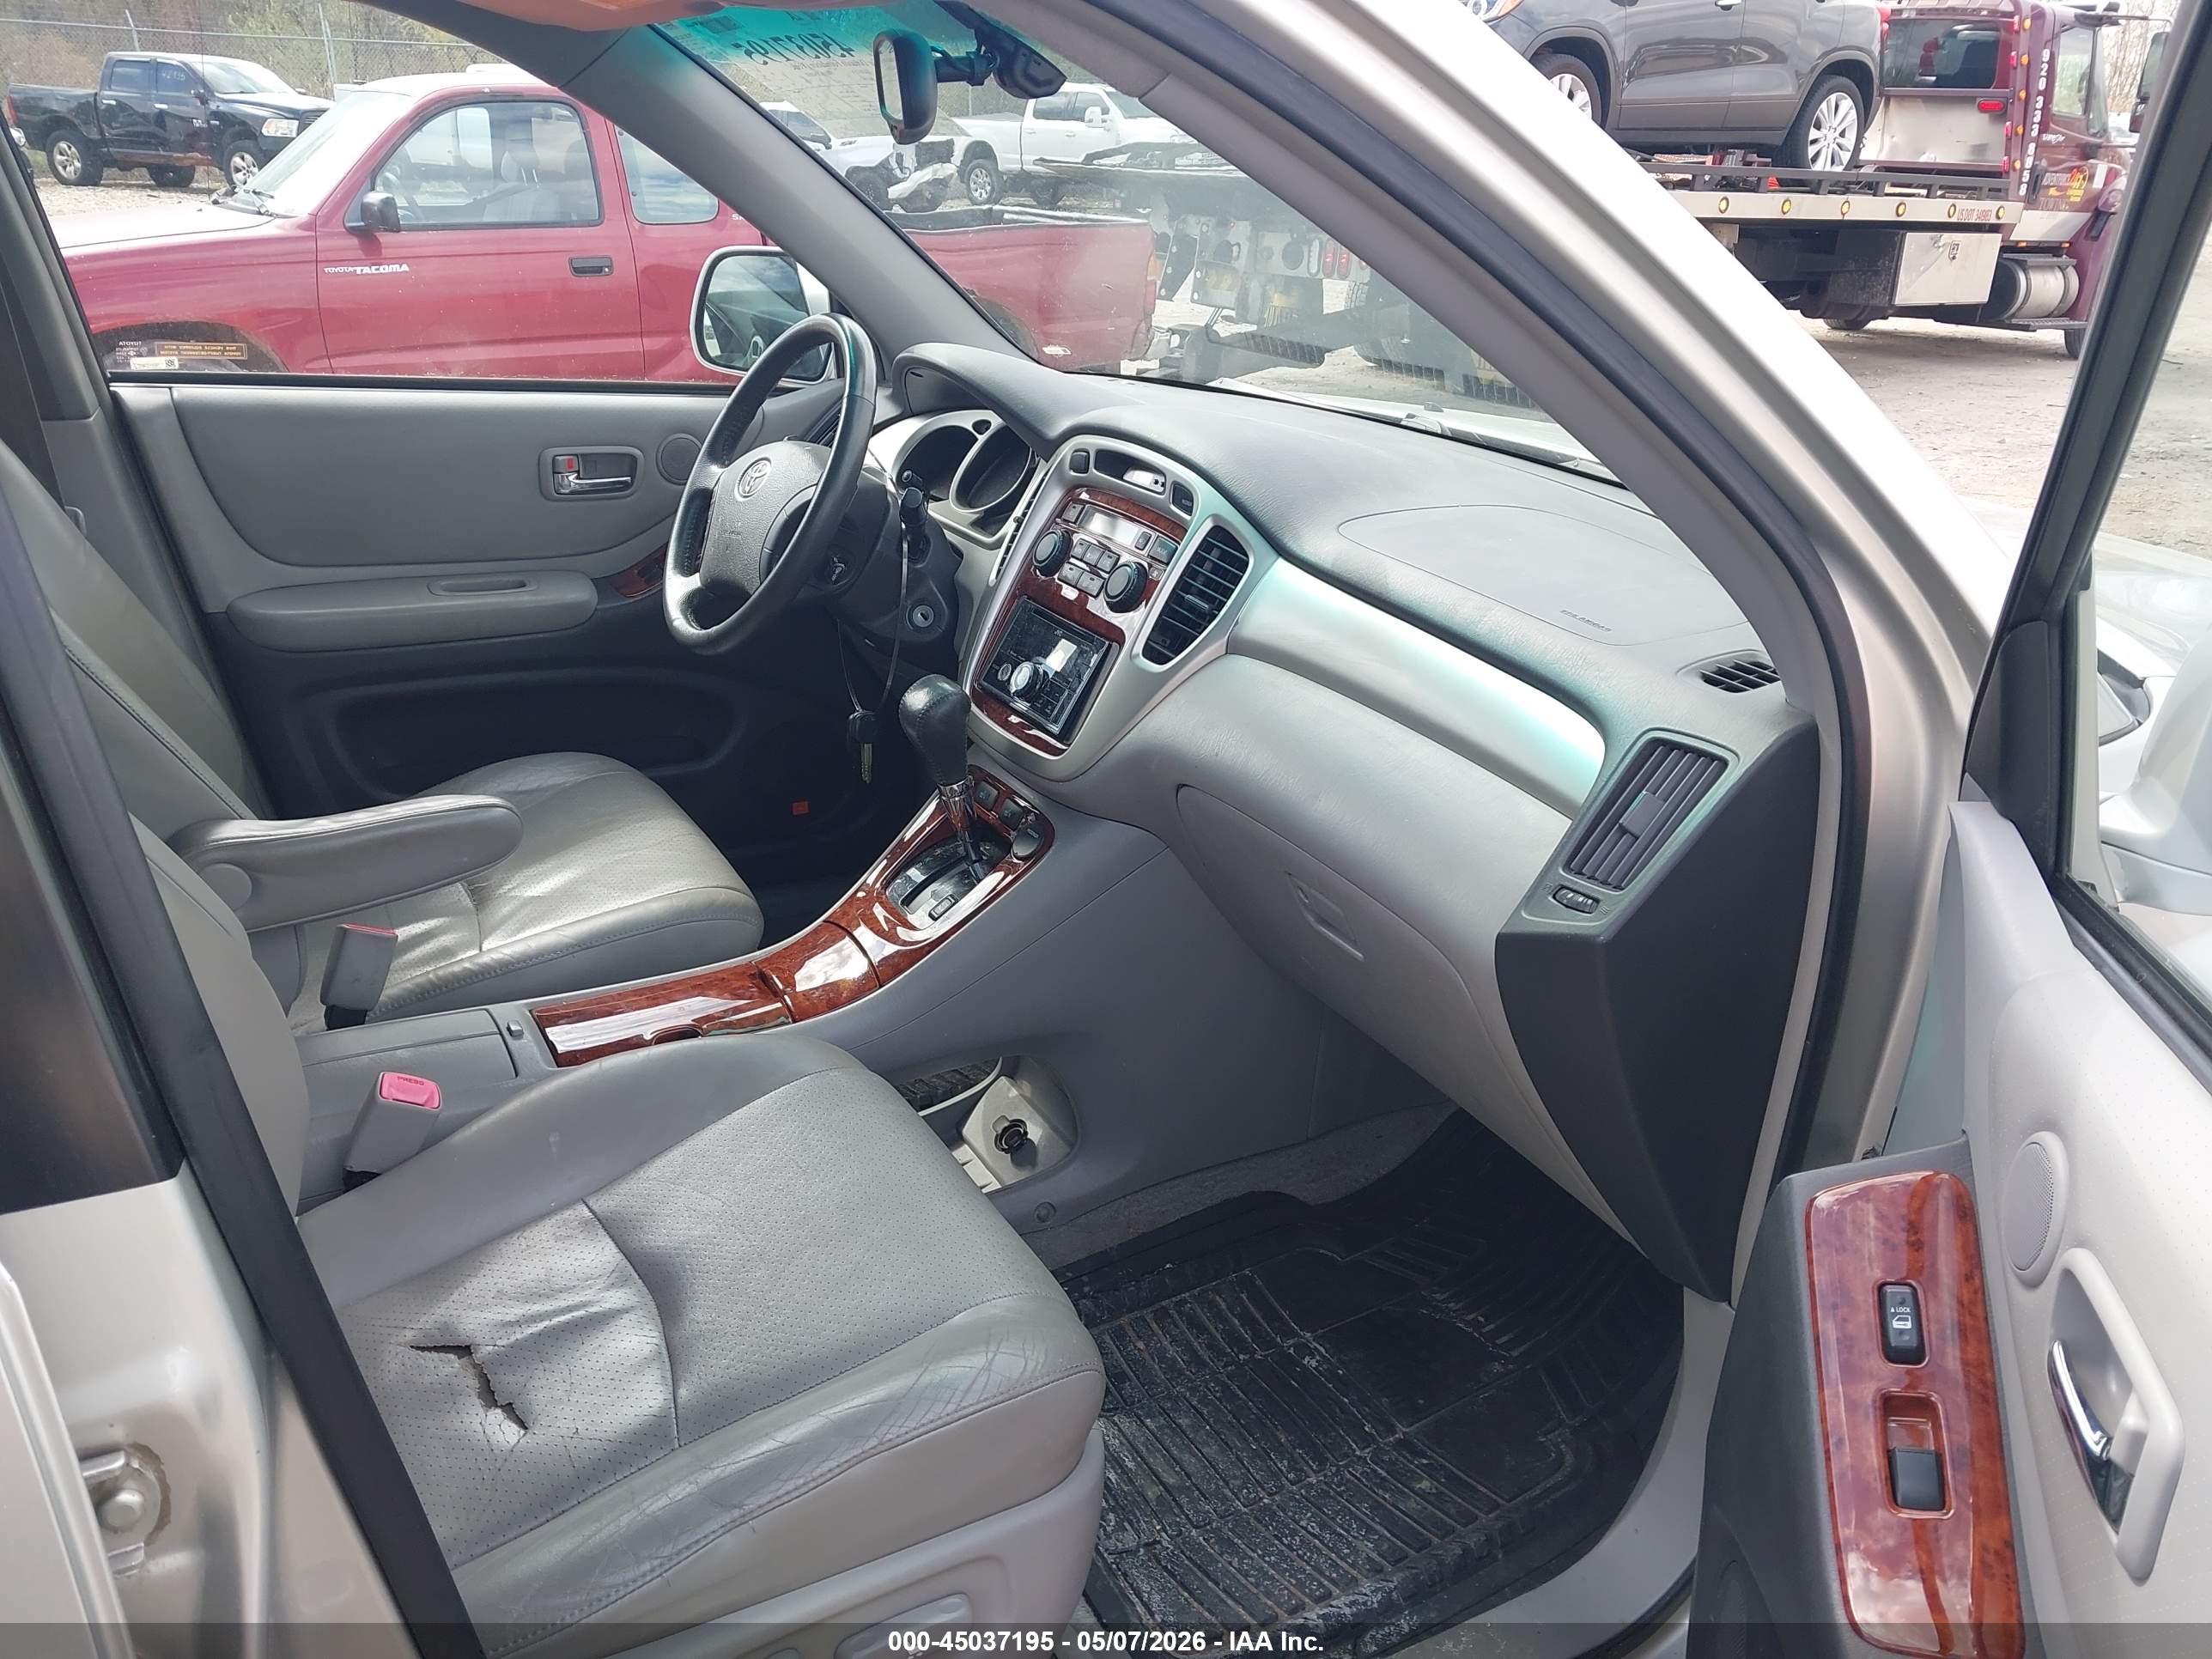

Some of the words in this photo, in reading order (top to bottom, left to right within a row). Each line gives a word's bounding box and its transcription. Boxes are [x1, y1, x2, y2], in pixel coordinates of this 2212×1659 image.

[2039, 49, 2051, 91] 920
[2030, 96, 2044, 137] 333
[356, 264, 410, 275] TACOMA
[397, 1076, 425, 1086] PRESS
